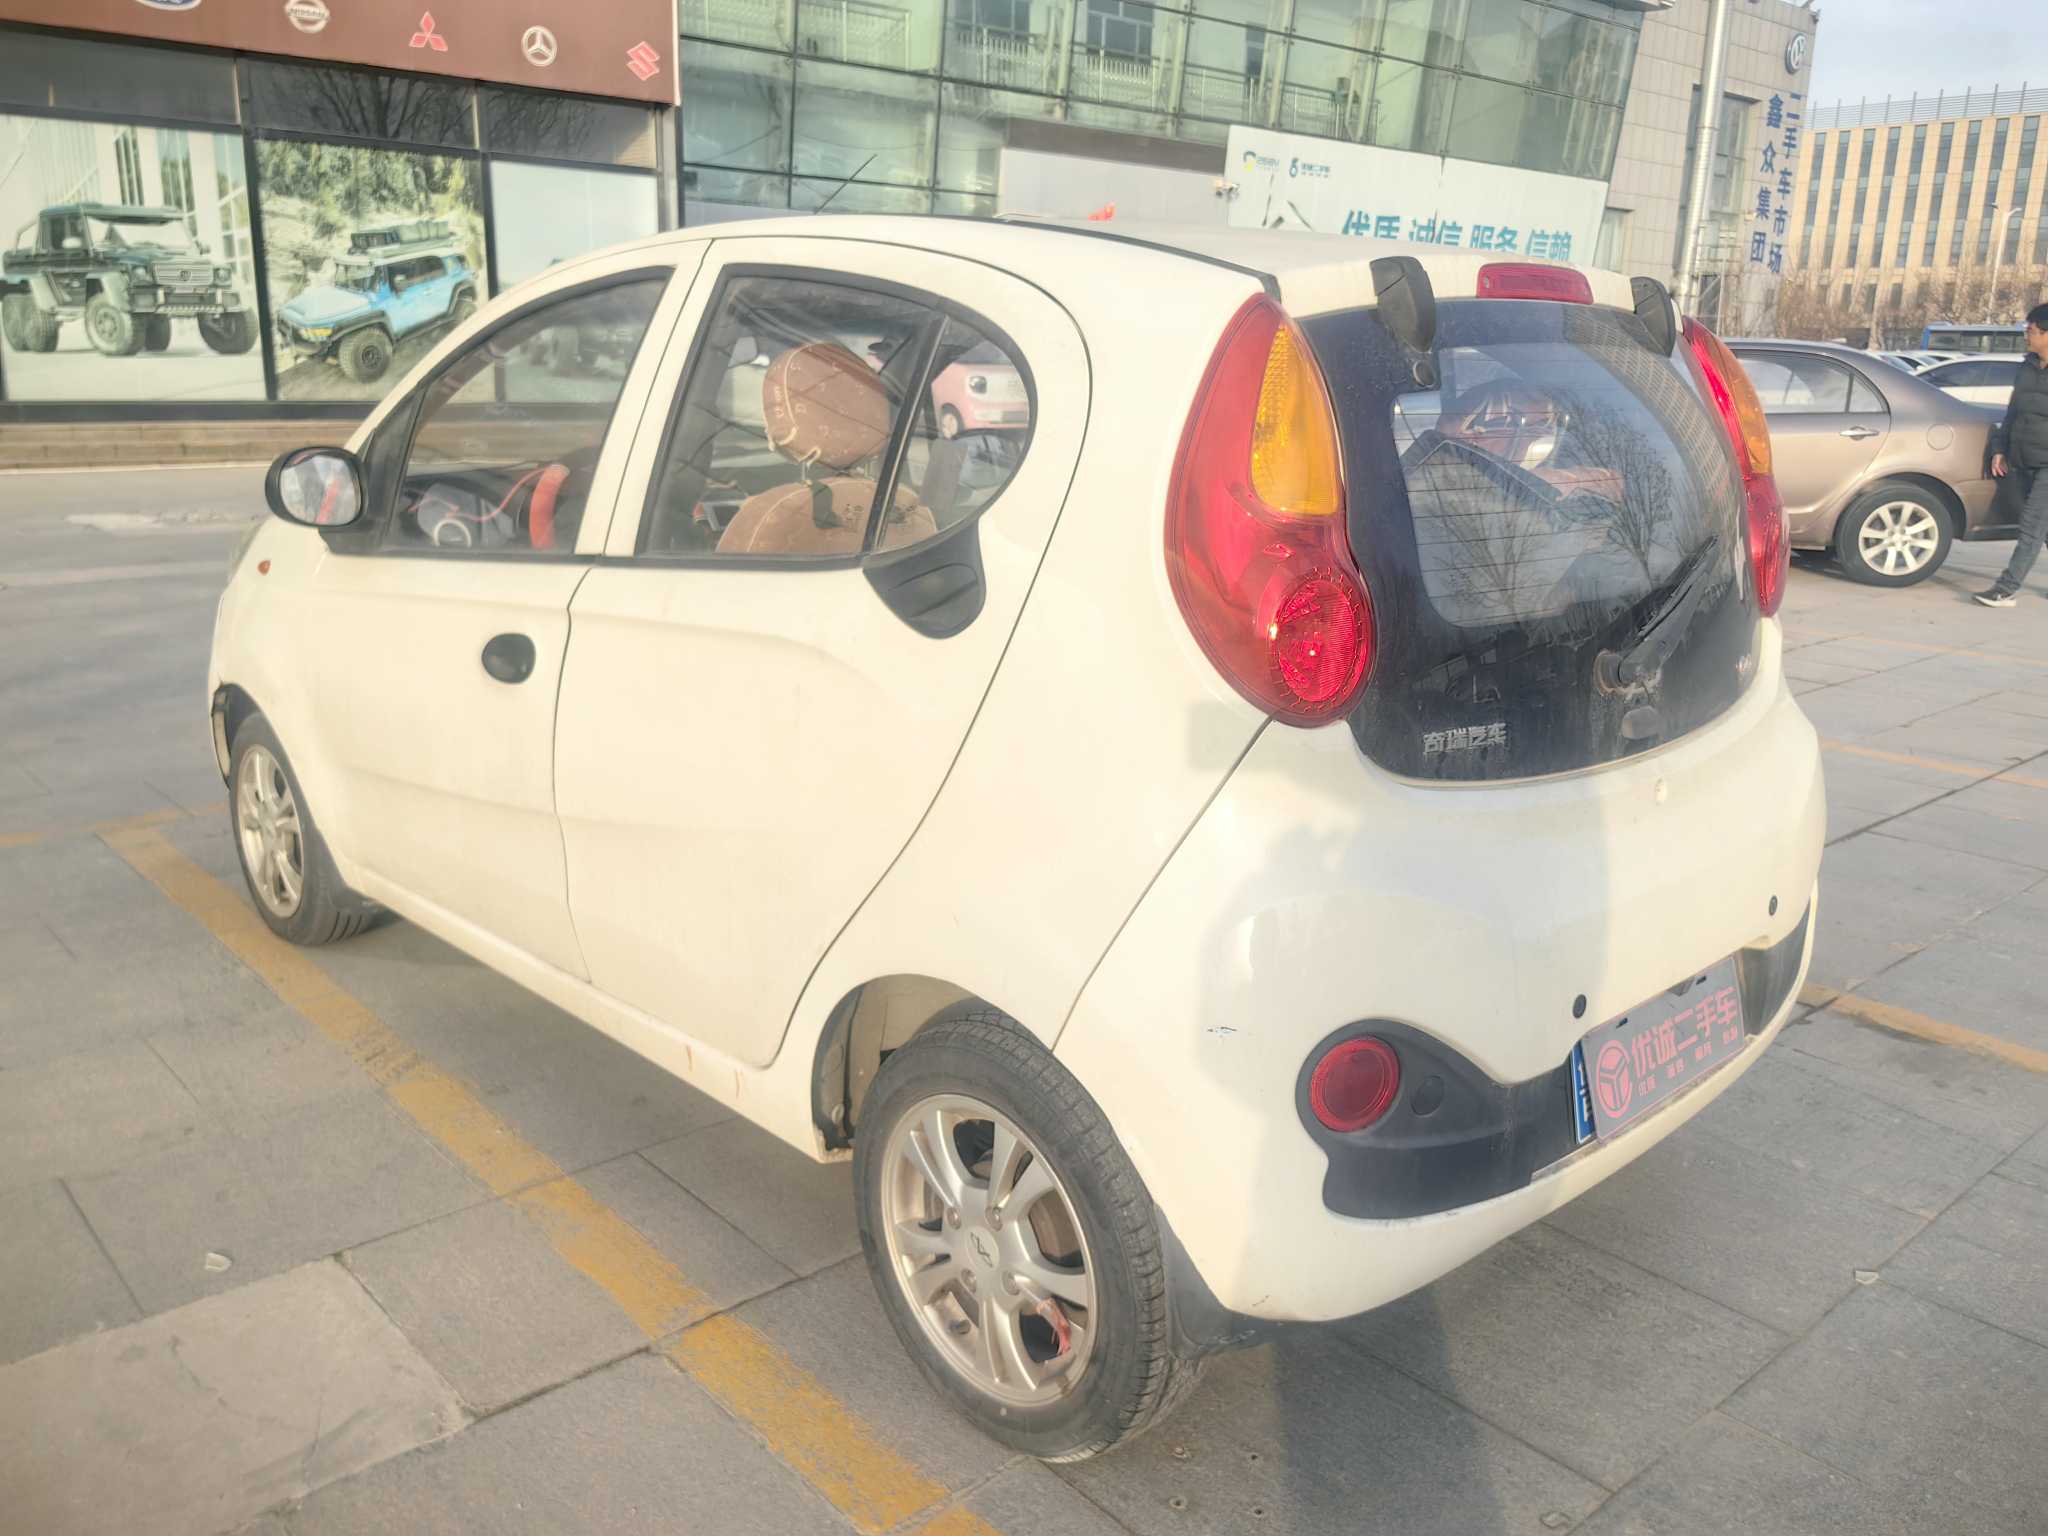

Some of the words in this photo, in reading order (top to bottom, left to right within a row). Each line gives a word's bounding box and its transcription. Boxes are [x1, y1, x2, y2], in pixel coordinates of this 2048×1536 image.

[1750, 93, 1784, 263] 鑫众集团
[1767, 92, 1801, 275] 二手车市场
[1422, 722, 1507, 754] 奇瑞汽车
